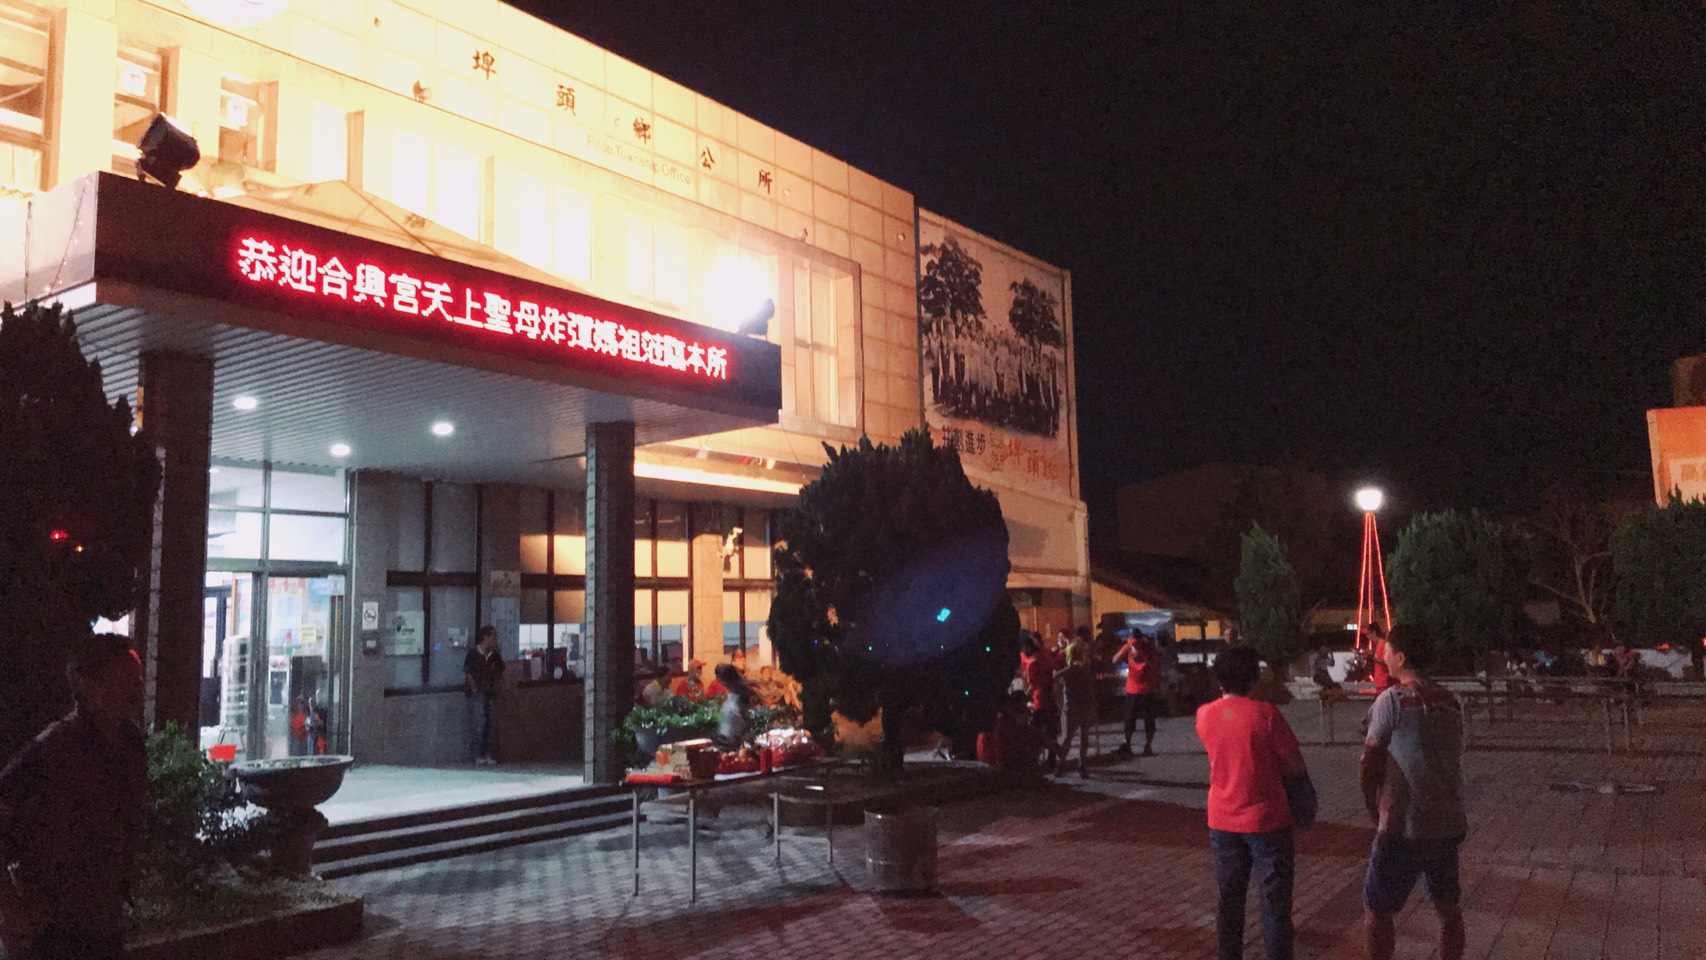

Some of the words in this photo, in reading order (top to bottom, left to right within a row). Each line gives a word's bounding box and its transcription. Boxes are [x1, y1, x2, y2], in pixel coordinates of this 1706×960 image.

[472, 49, 773, 195] 埤頭鄉公所
[614, 144, 660, 174] Township
[661, 162, 692, 185] Office
